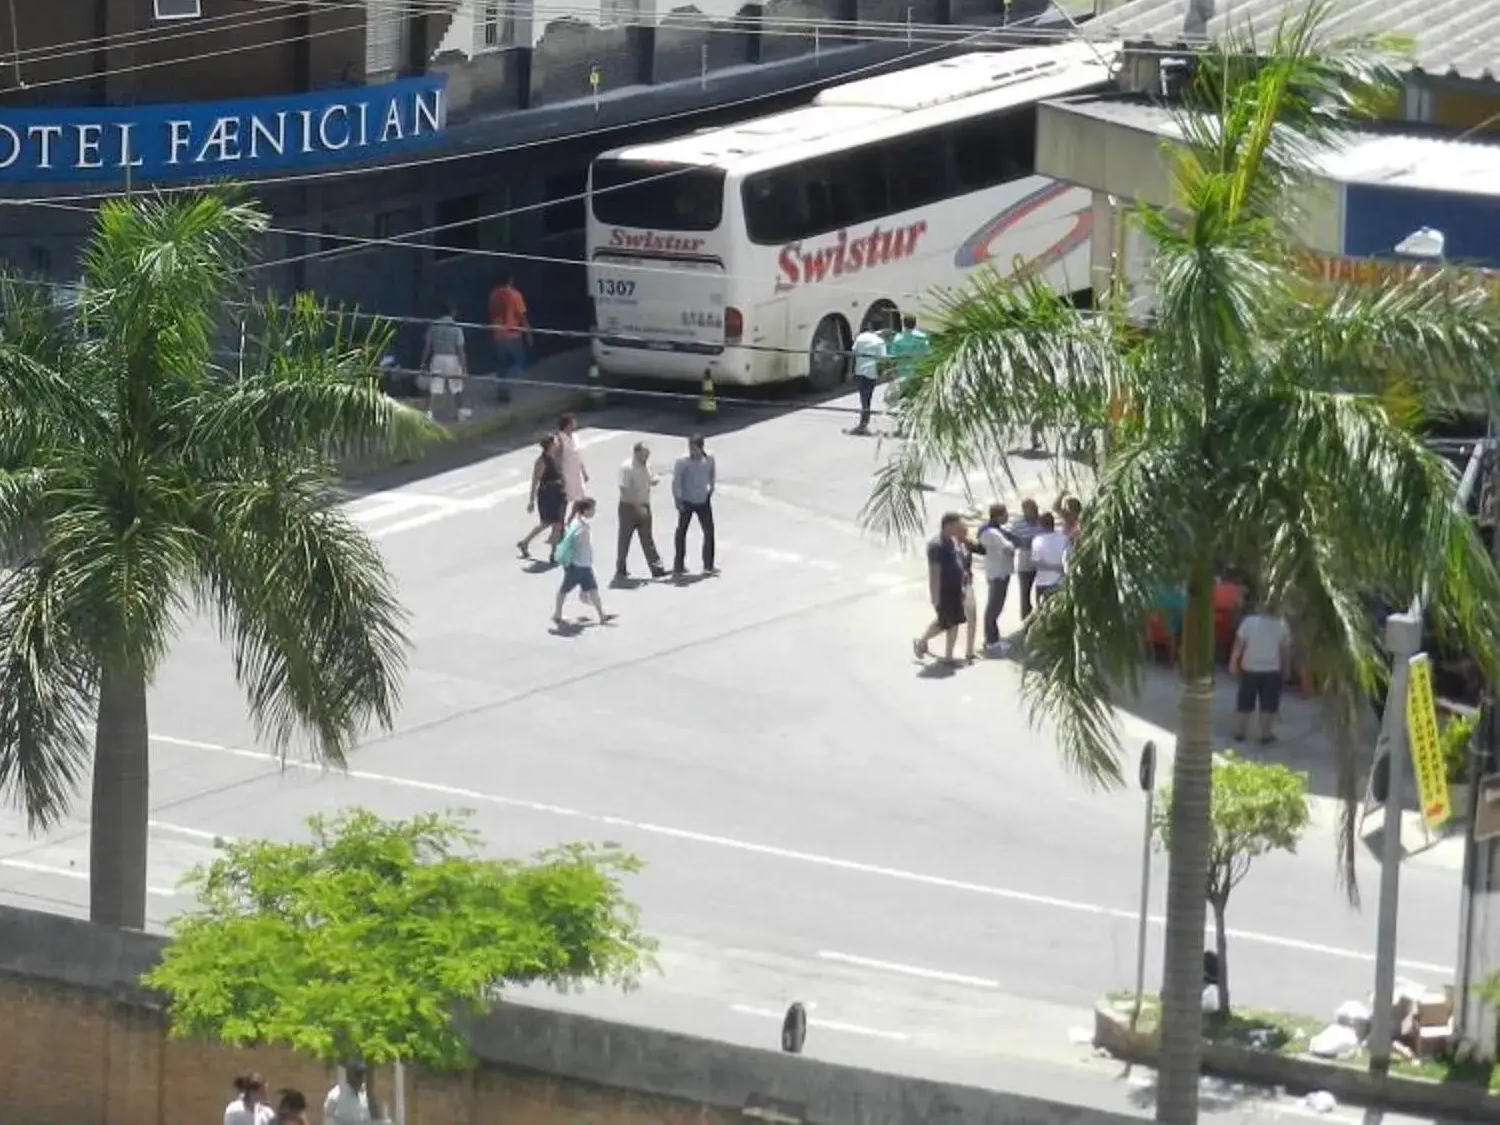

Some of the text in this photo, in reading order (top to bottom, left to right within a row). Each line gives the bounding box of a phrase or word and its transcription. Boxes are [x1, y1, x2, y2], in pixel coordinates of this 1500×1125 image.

[608, 228, 706, 251] Swistur
[774, 219, 928, 294] Swistur
[597, 278, 636, 296] 1307
